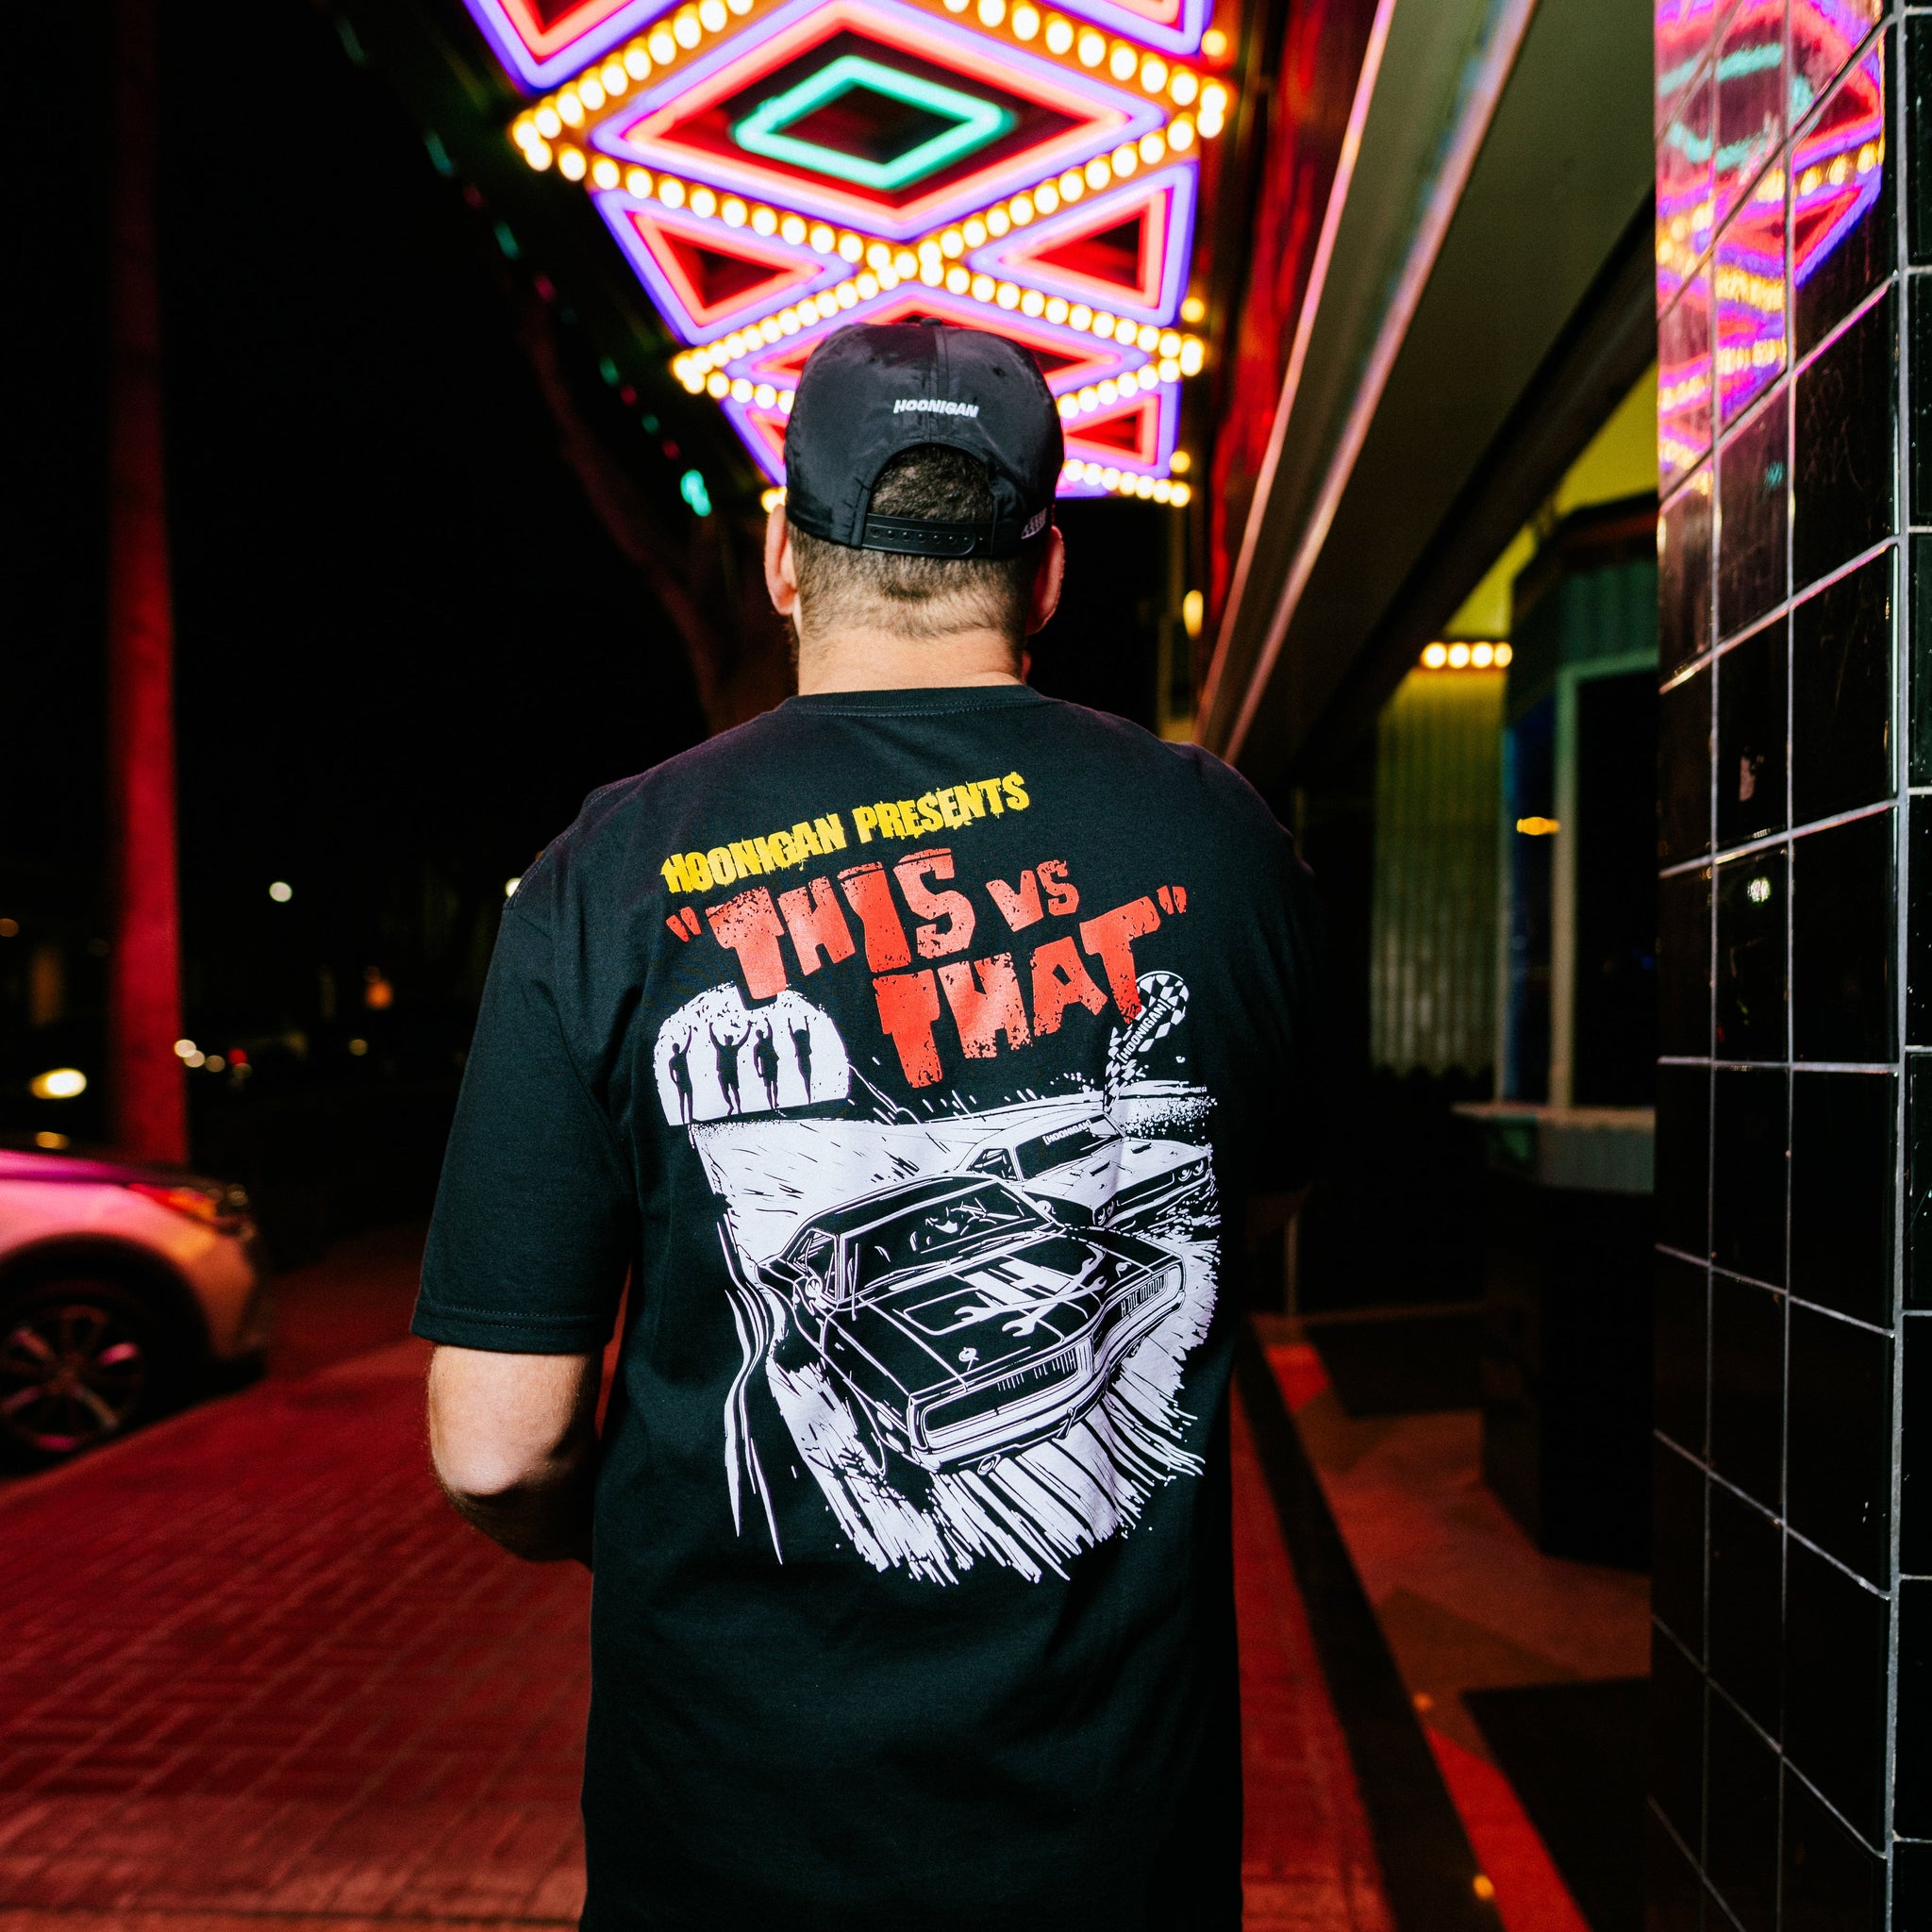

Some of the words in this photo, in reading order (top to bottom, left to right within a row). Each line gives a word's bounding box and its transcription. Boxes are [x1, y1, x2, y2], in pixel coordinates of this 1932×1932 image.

[892, 399, 979, 418] HOONIGAN
[660, 814, 846, 893] HOONIGAN
[852, 772, 1030, 843] PRESENTS
